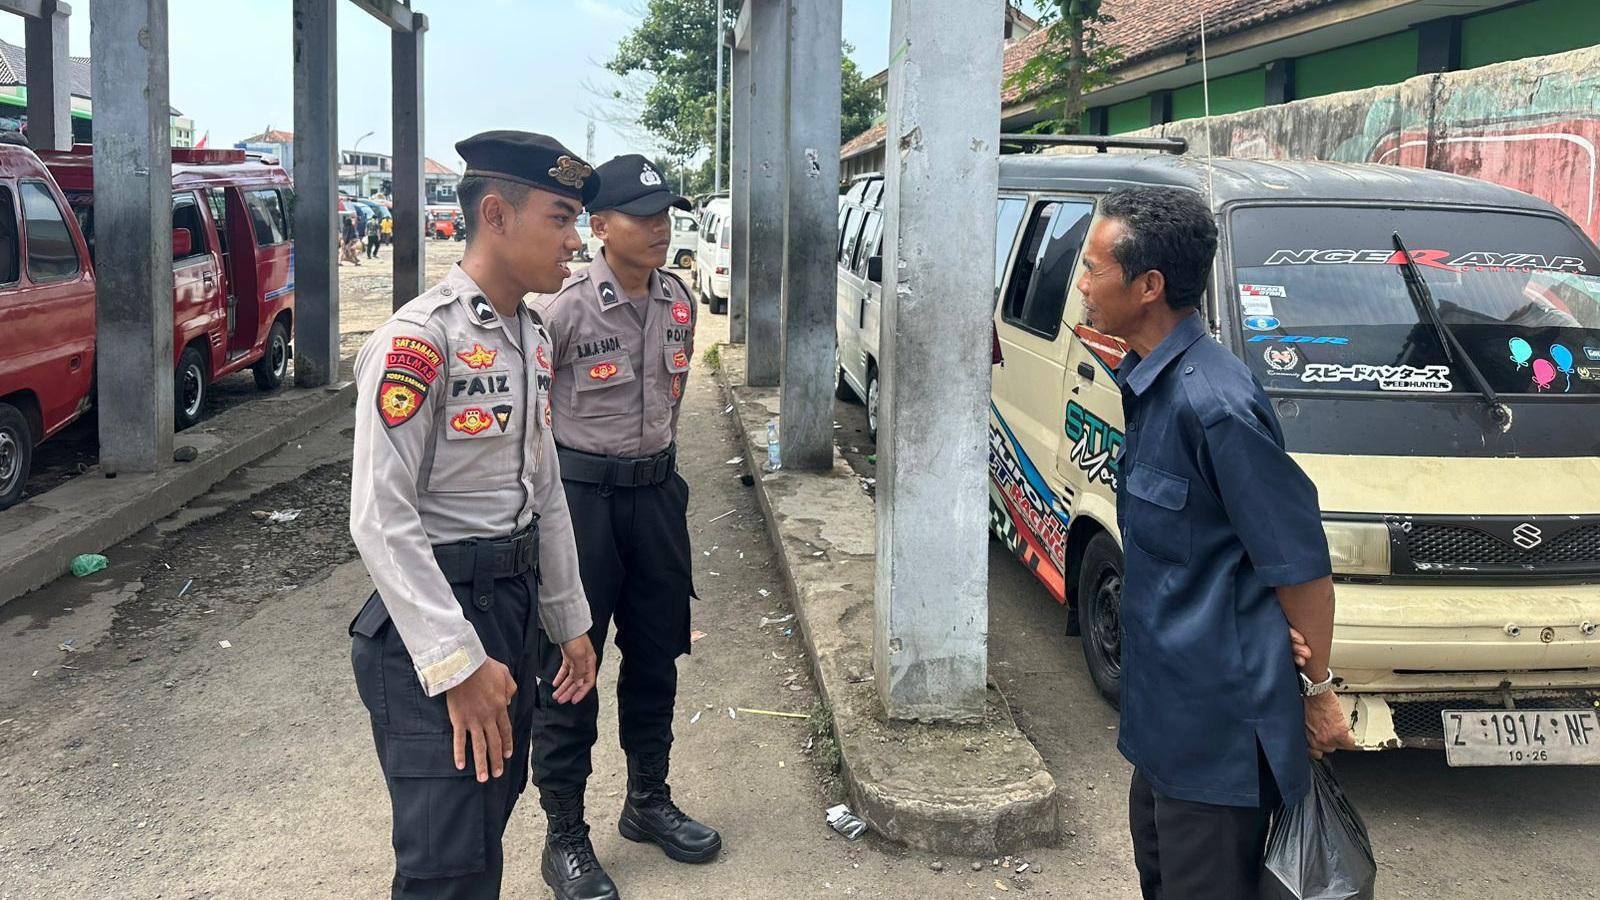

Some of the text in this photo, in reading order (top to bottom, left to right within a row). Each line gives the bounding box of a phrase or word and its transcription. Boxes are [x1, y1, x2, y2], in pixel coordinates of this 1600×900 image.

[1264, 249, 1584, 272] NGERAYAP
[395, 338, 440, 364] SAT SAMAPTA
[389, 354, 433, 379] DALMAS
[1304, 365, 1447, 381] スピードハンターズ
[452, 375, 510, 397] FAIZ
[1065, 399, 1126, 472] STIC
[1009, 481, 1065, 563] RACING
[1450, 714, 1594, 746] Z 1914 NF
